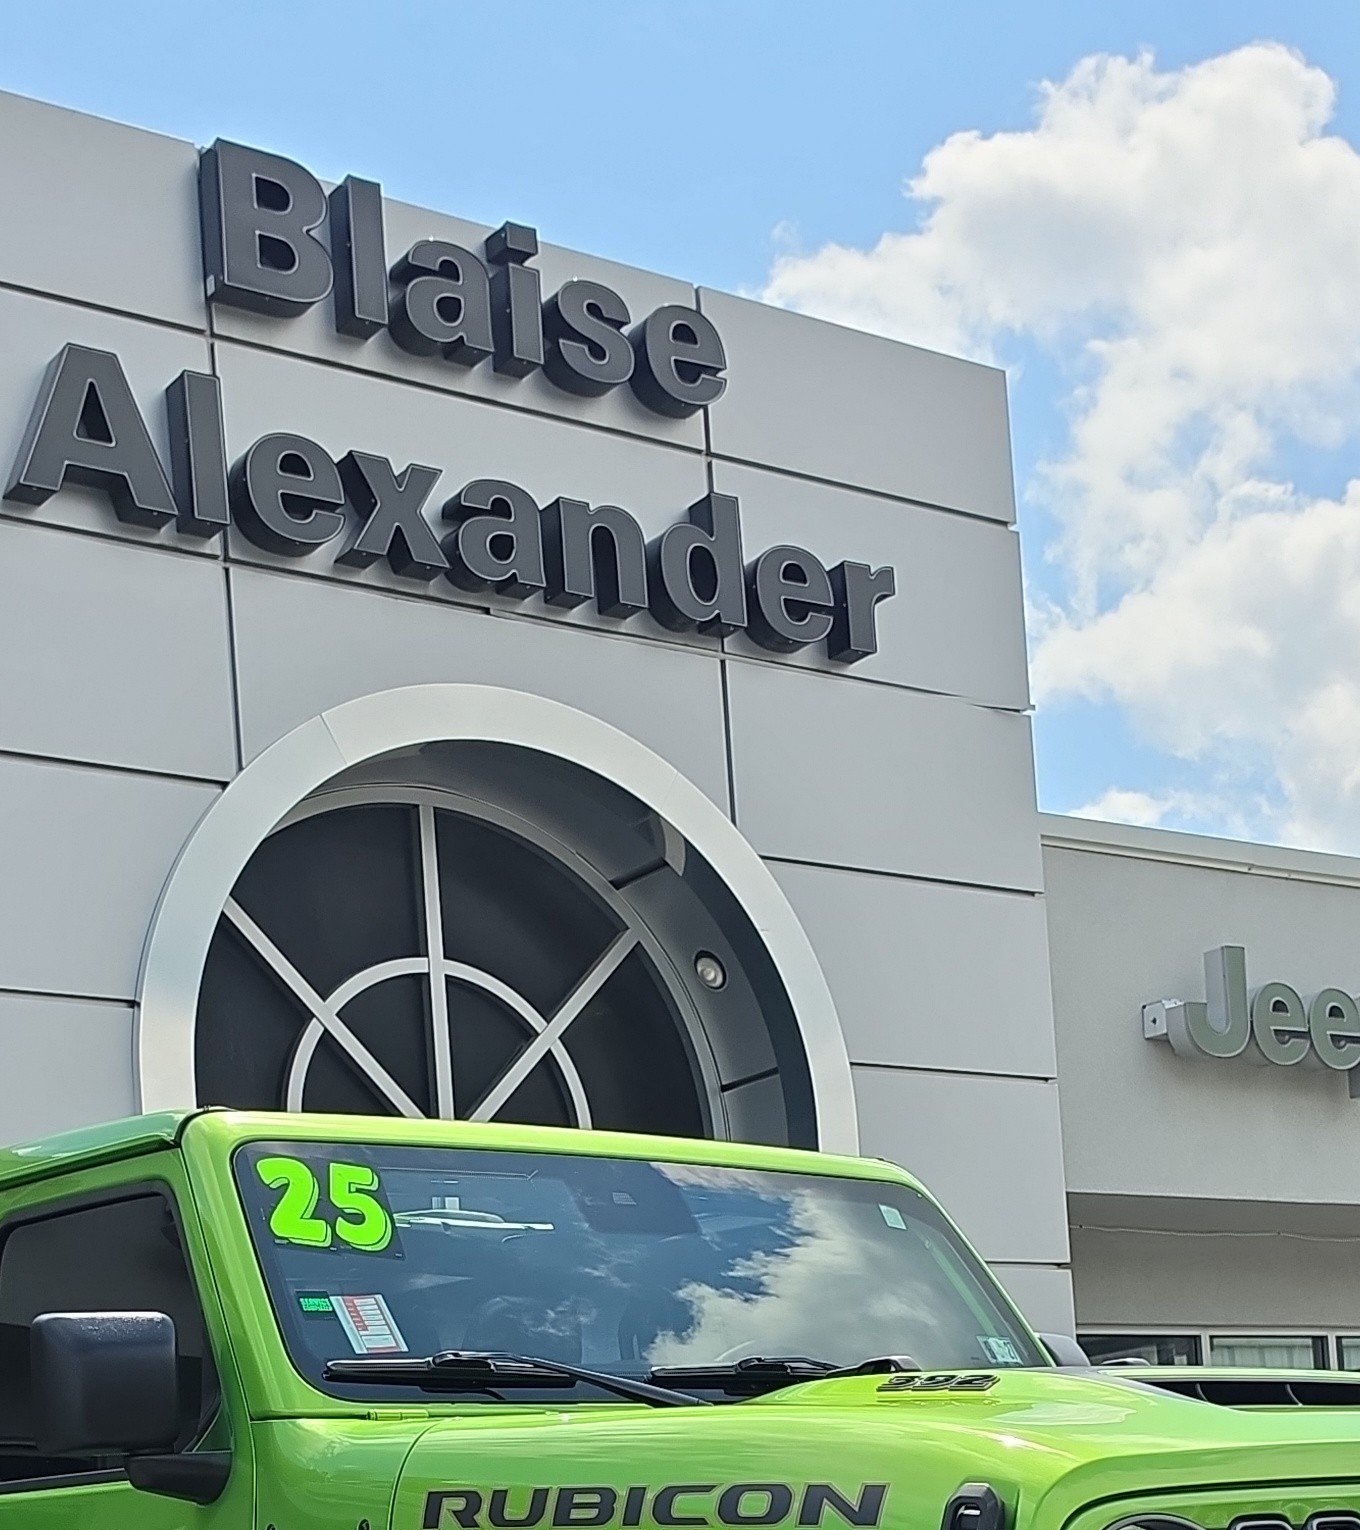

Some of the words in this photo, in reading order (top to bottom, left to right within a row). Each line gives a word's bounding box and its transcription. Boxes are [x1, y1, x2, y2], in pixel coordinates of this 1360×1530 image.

[199, 137, 728, 419] Blaise
[3, 342, 895, 663] Alexander
[255, 1157, 393, 1252] 25
[420, 1482, 890, 1530] RUBICON
